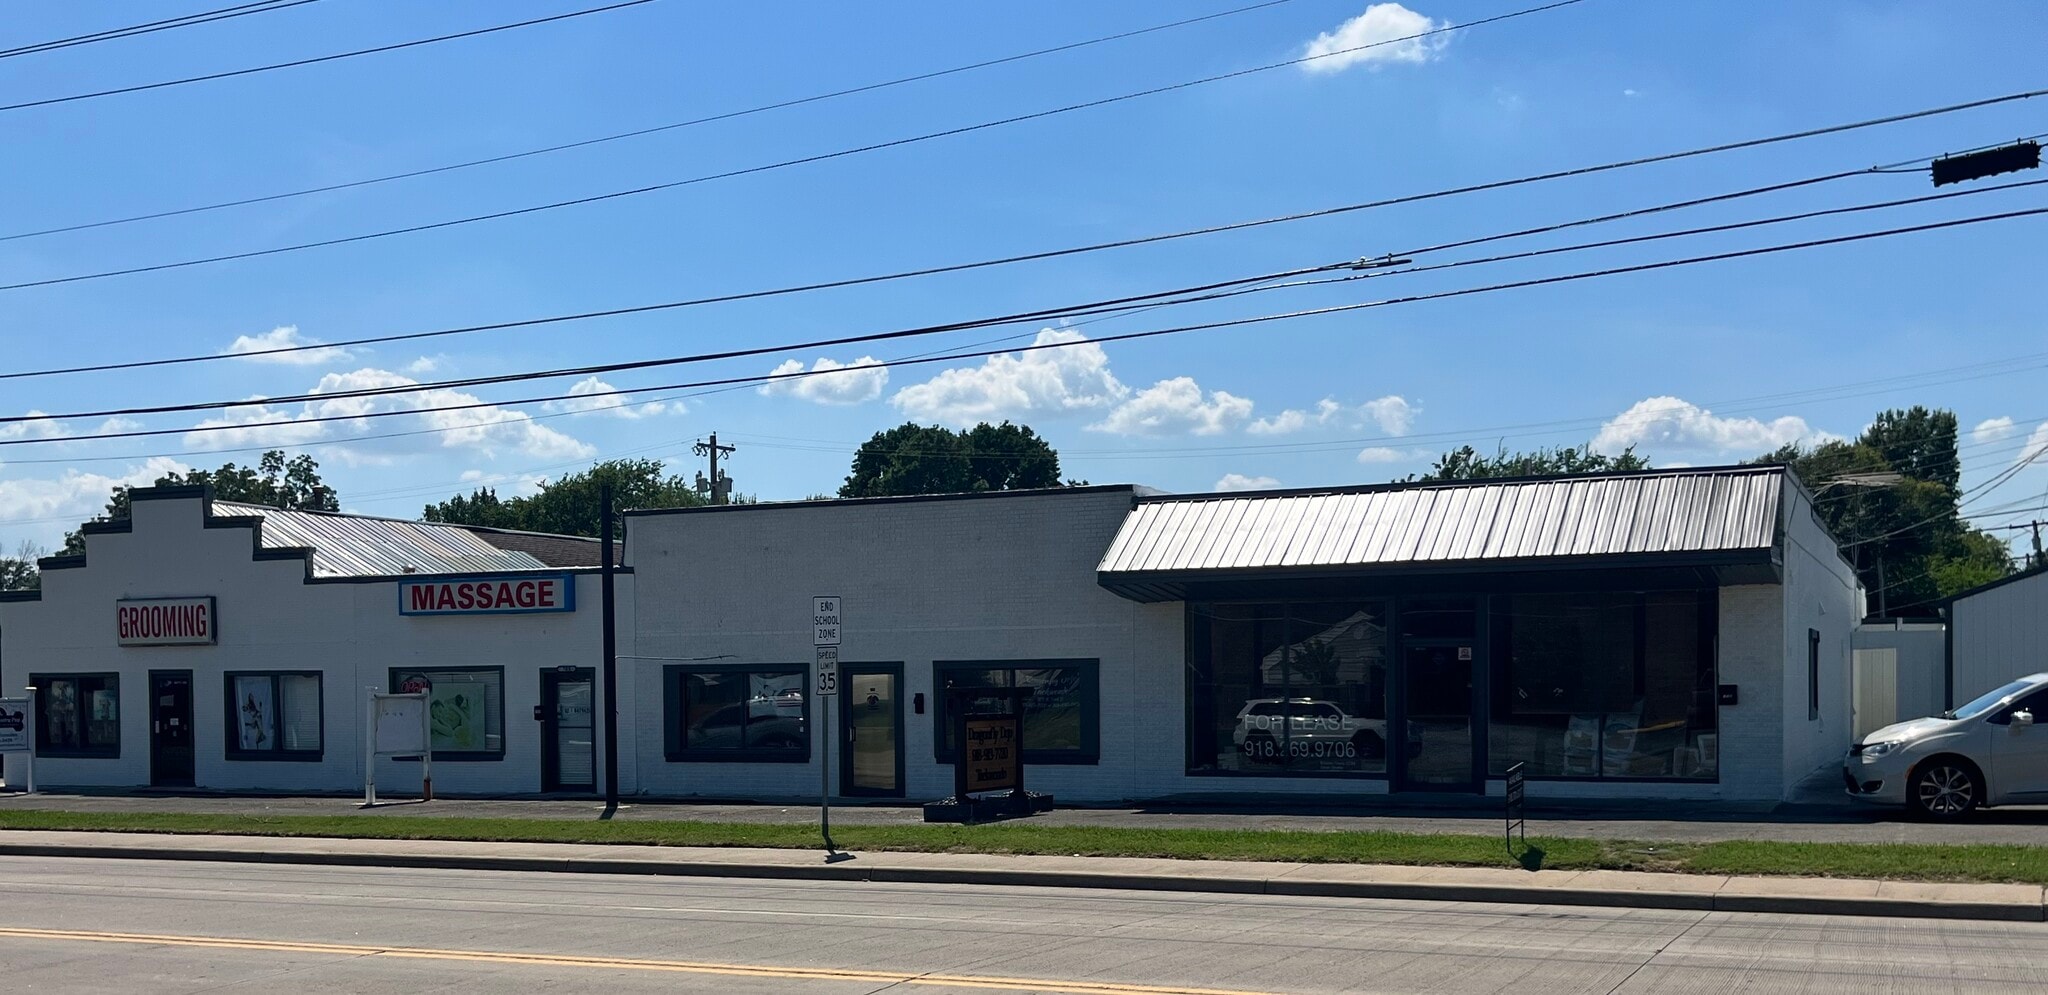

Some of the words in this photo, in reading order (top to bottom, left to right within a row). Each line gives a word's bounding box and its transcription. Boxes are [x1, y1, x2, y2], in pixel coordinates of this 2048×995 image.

[411, 581, 554, 611] MASSAGE
[820, 601, 833, 611] END
[119, 603, 207, 638] GROOMING
[815, 616, 839, 625] SCHOOL
[819, 629, 836, 639] ZONE
[818, 651, 836, 660] SPEED
[820, 662, 834, 670] LIMIT
[819, 672, 836, 690] 35
[1244, 714, 1284, 730] FOR
[1291, 714, 1355, 731] LEASE
